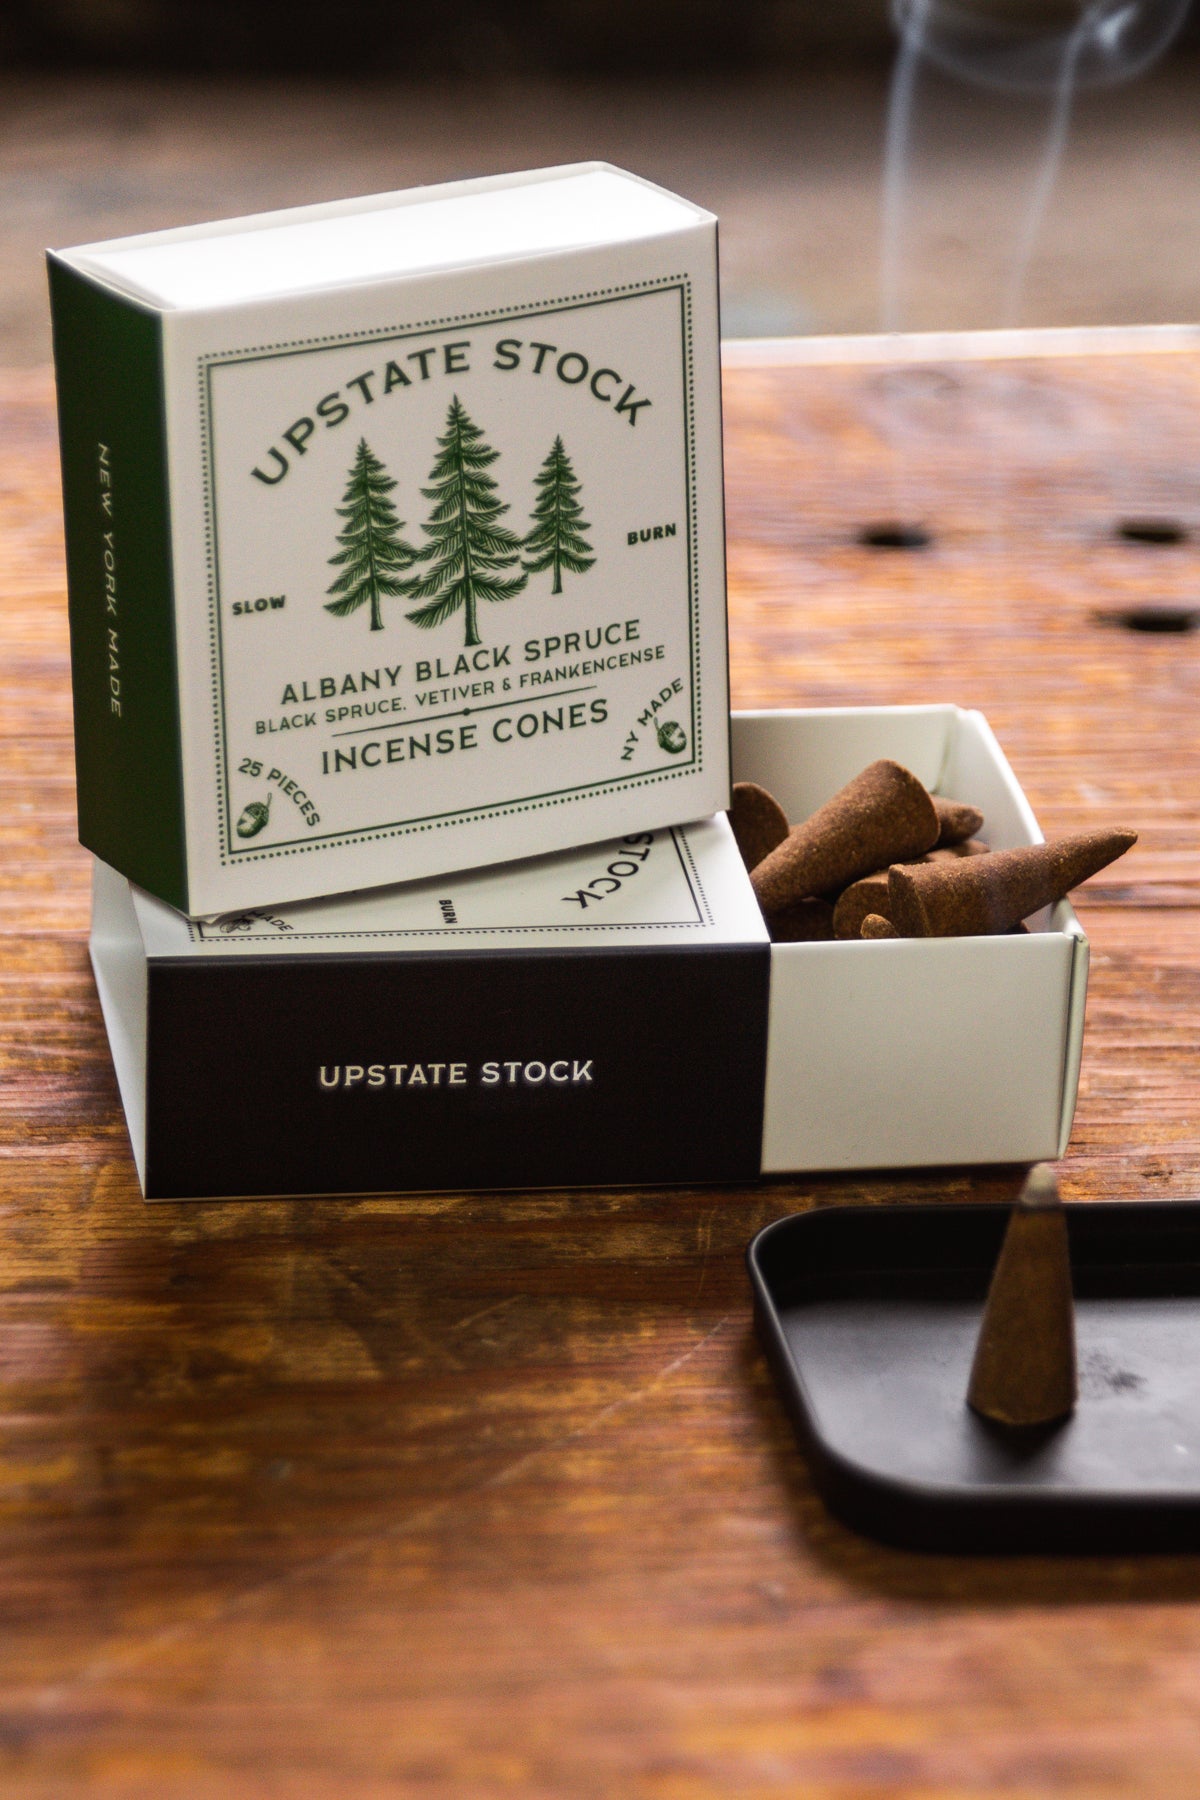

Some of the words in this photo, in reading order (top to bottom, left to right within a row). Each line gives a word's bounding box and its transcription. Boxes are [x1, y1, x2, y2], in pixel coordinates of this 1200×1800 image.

[250, 341, 472, 486] UPSTATE
[492, 339, 652, 427] STOCK
[98, 442, 112, 517] NEW
[626, 522, 677, 546] BURN
[103, 531, 118, 616] YORK
[232, 594, 286, 616] SLOW
[108, 627, 123, 718] MADE
[255, 712, 317, 735] BLACK
[415, 680, 495, 706] VETIVER
[502, 677, 512, 691] &
[519, 645, 666, 688] FRANKENCENSE
[281, 665, 402, 705] ALBANY
[415, 645, 512, 682] BLACK
[524, 619, 641, 662] SPRUCE
[322, 724, 478, 774] INCENSE
[492, 698, 609, 743] CONES
[620, 730, 640, 762] NY
[637, 677, 684, 727] MADE
[238, 757, 264, 778] 25
[266, 768, 321, 827] PIECES
[561, 832, 654, 909] STOCK
[439, 899, 458, 925] BURN
[319, 1063, 468, 1087] UPSTATE
[480, 1060, 594, 1084] STOCK
